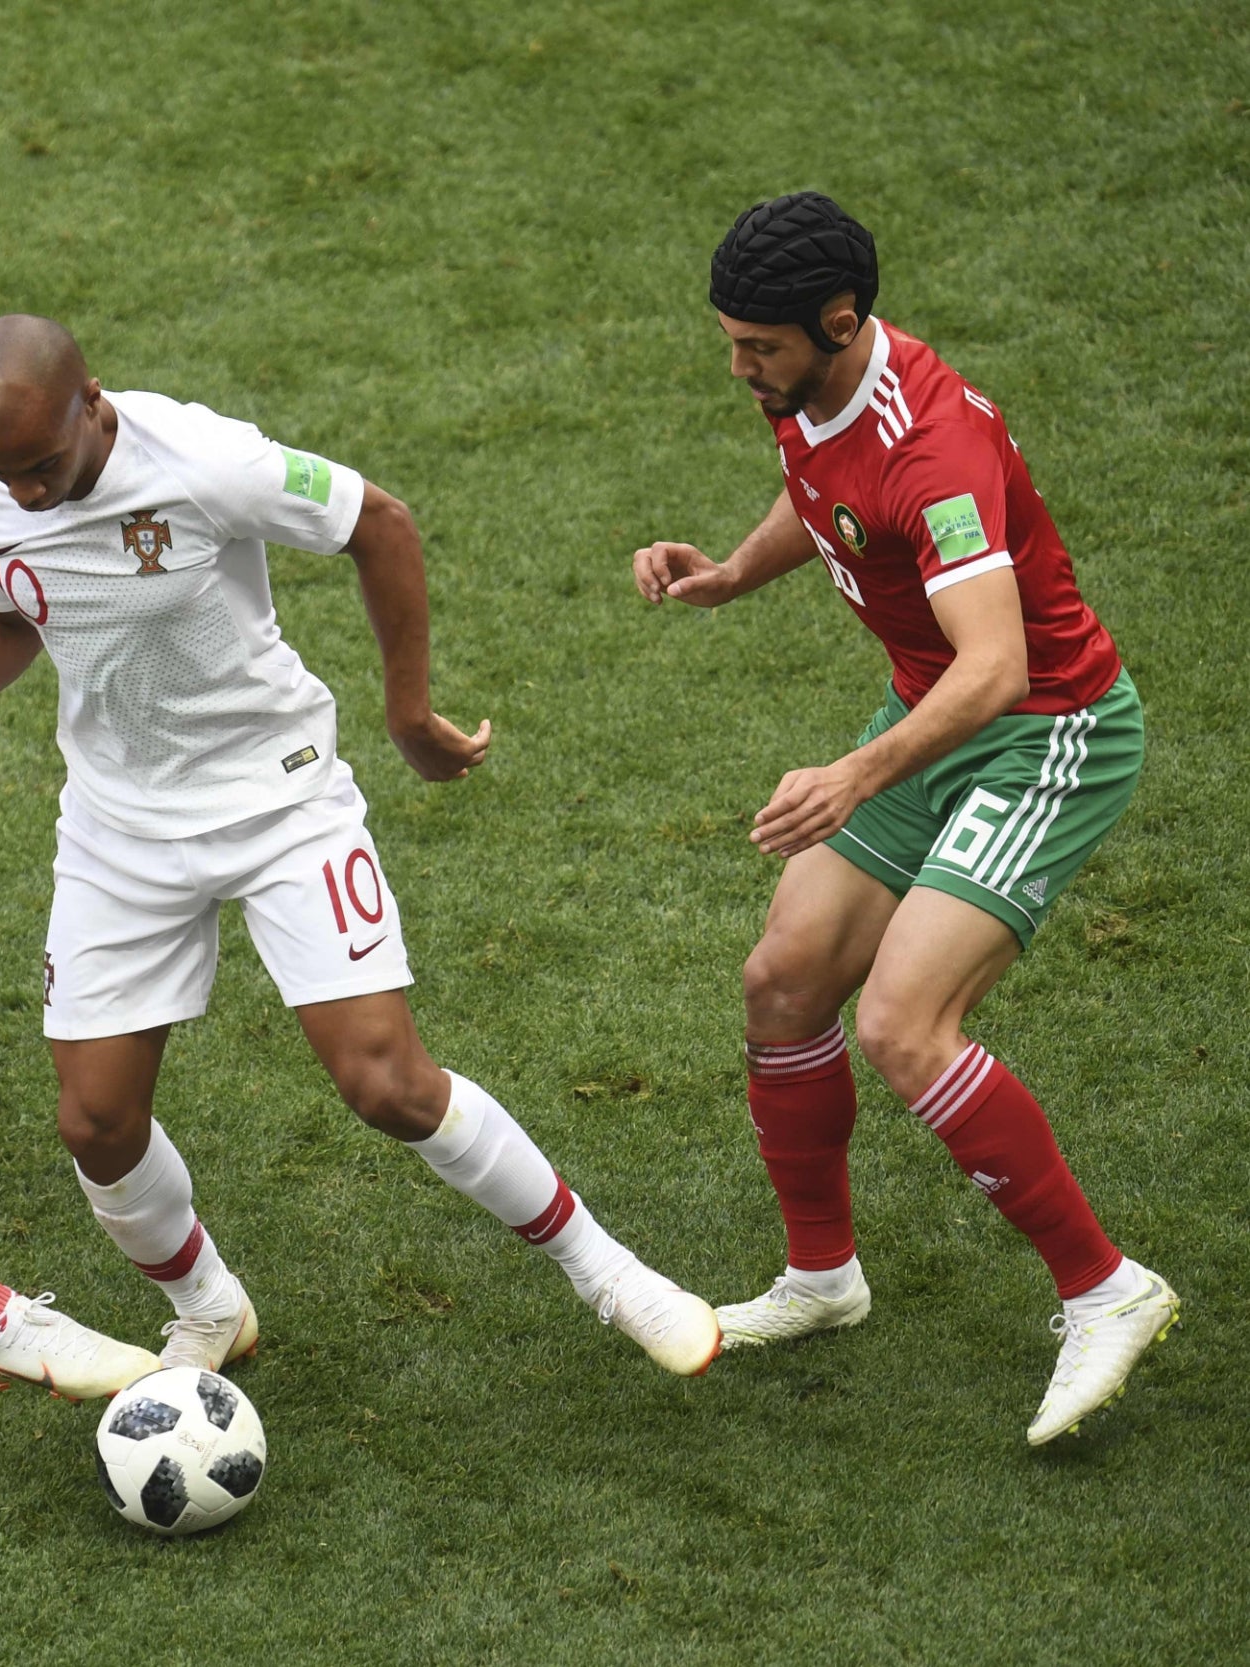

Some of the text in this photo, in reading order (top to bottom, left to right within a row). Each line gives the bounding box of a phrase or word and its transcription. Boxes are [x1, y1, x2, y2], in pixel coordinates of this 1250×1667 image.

[932, 511, 975, 531] LIVING
[964, 530, 981, 540] FIFA
[322, 847, 384, 934] 10
